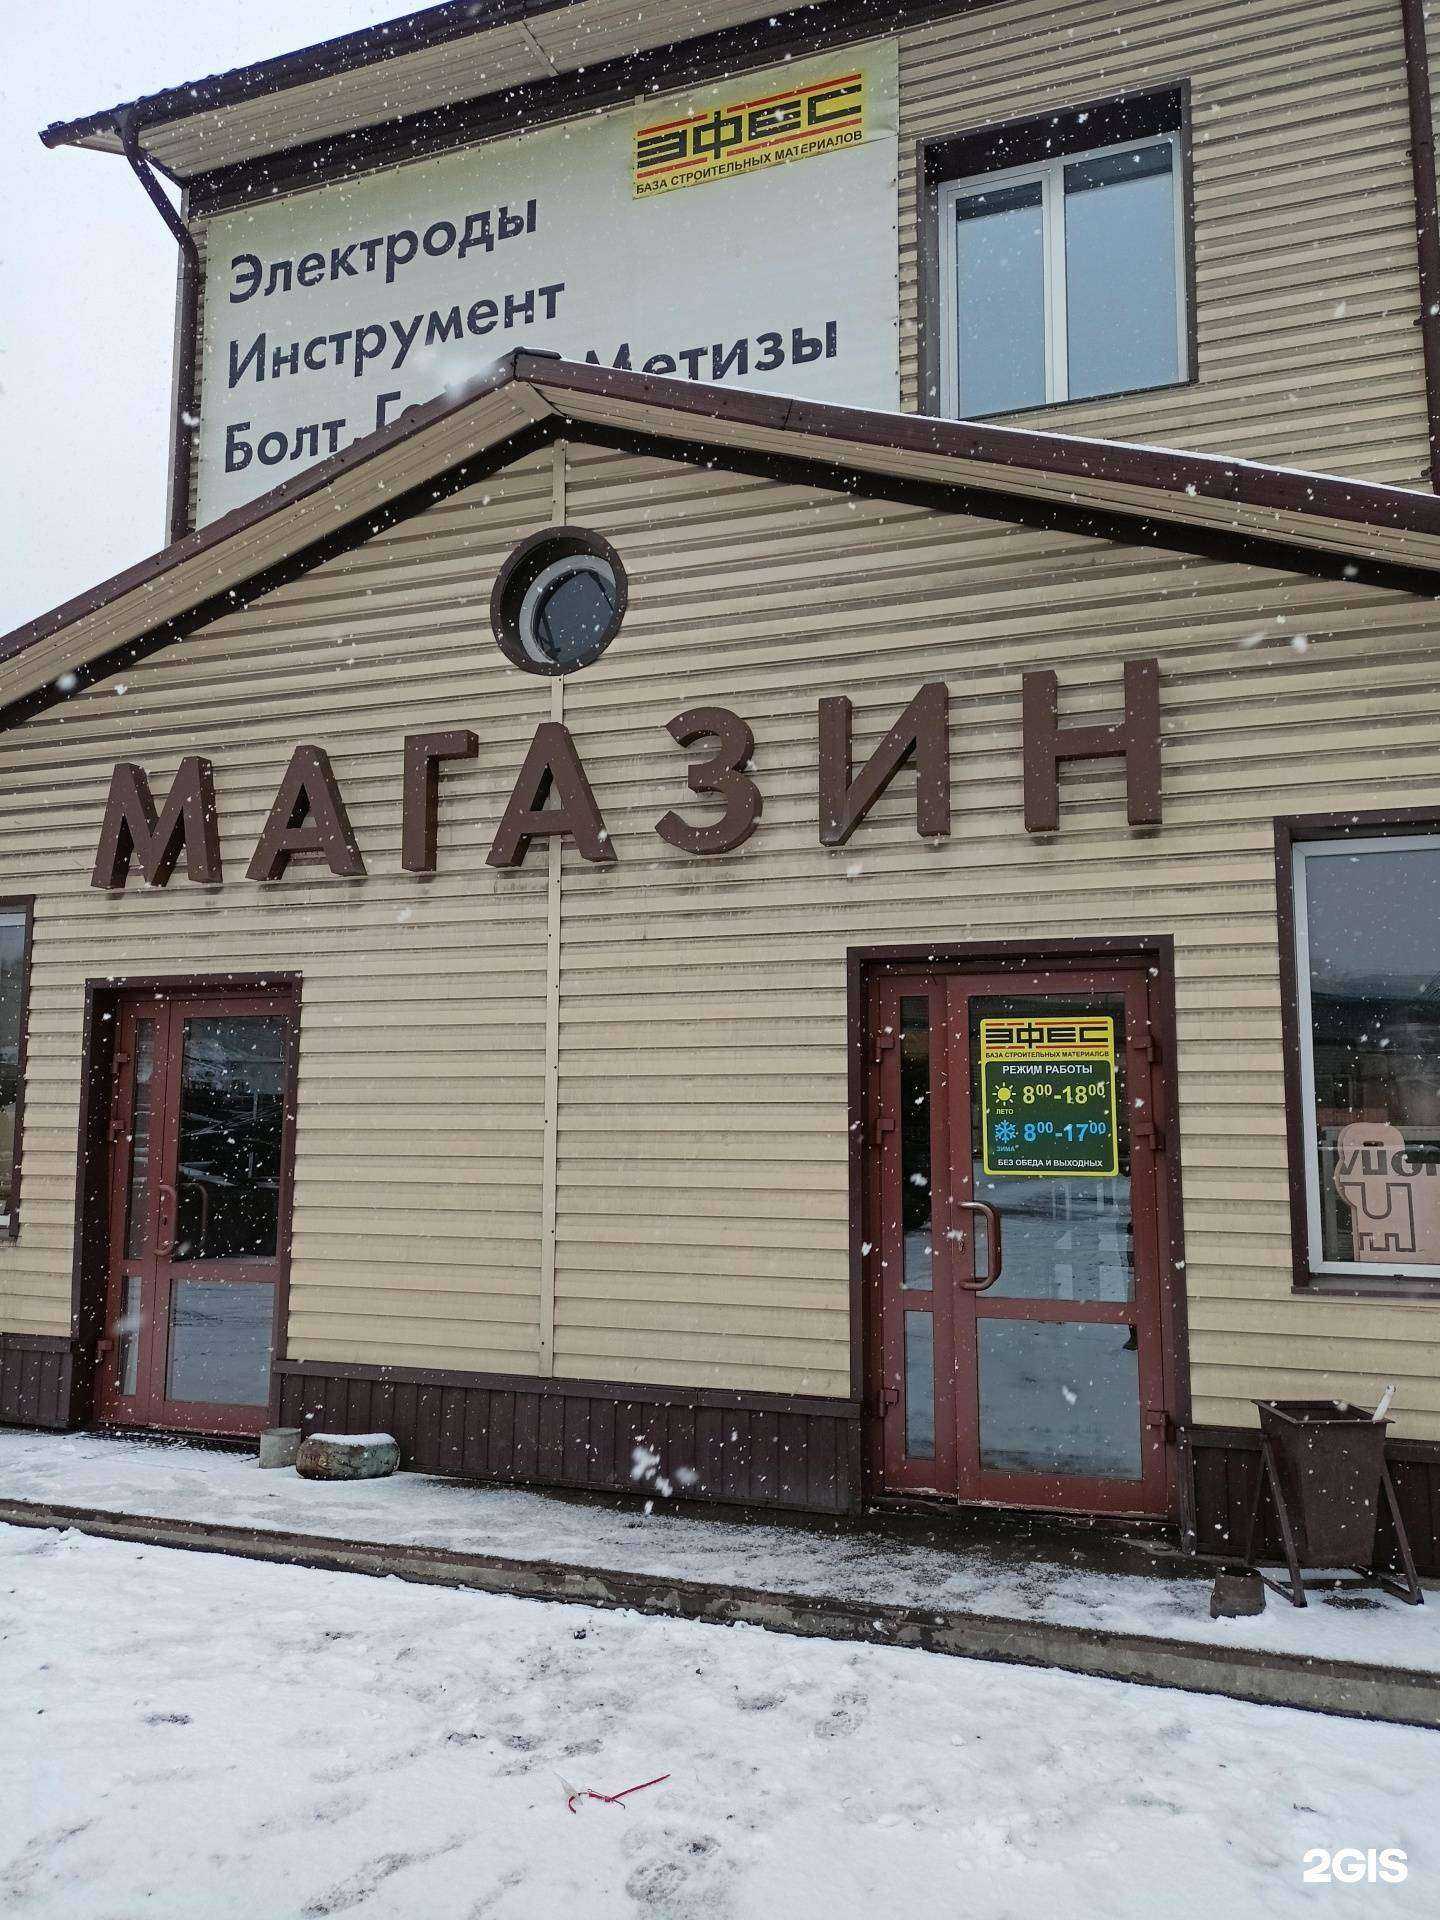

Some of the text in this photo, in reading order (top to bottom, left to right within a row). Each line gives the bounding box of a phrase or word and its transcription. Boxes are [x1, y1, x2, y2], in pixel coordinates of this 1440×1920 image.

[637, 83, 863, 170] ЭФЕС
[635, 129, 863, 195] БАЗА СТРОИТЕЛЬНЫХ МАТЕРИАЛОВ
[229, 198, 537, 304] Электроды
[228, 282, 566, 389] Инструмент
[92, 657, 1163, 890] МАГАЗИН
[985, 1021, 1109, 1050] ЭФЕС
[1005, 1051, 1061, 1059] СТРОИТЕЛЬНЫХ
[1002, 1064, 1093, 1075] РЕЖИМ РАБОТЫ
[997, 1159, 1103, 1168] БЕЗ ОБЕДА И ВЫХОДНЫХ
